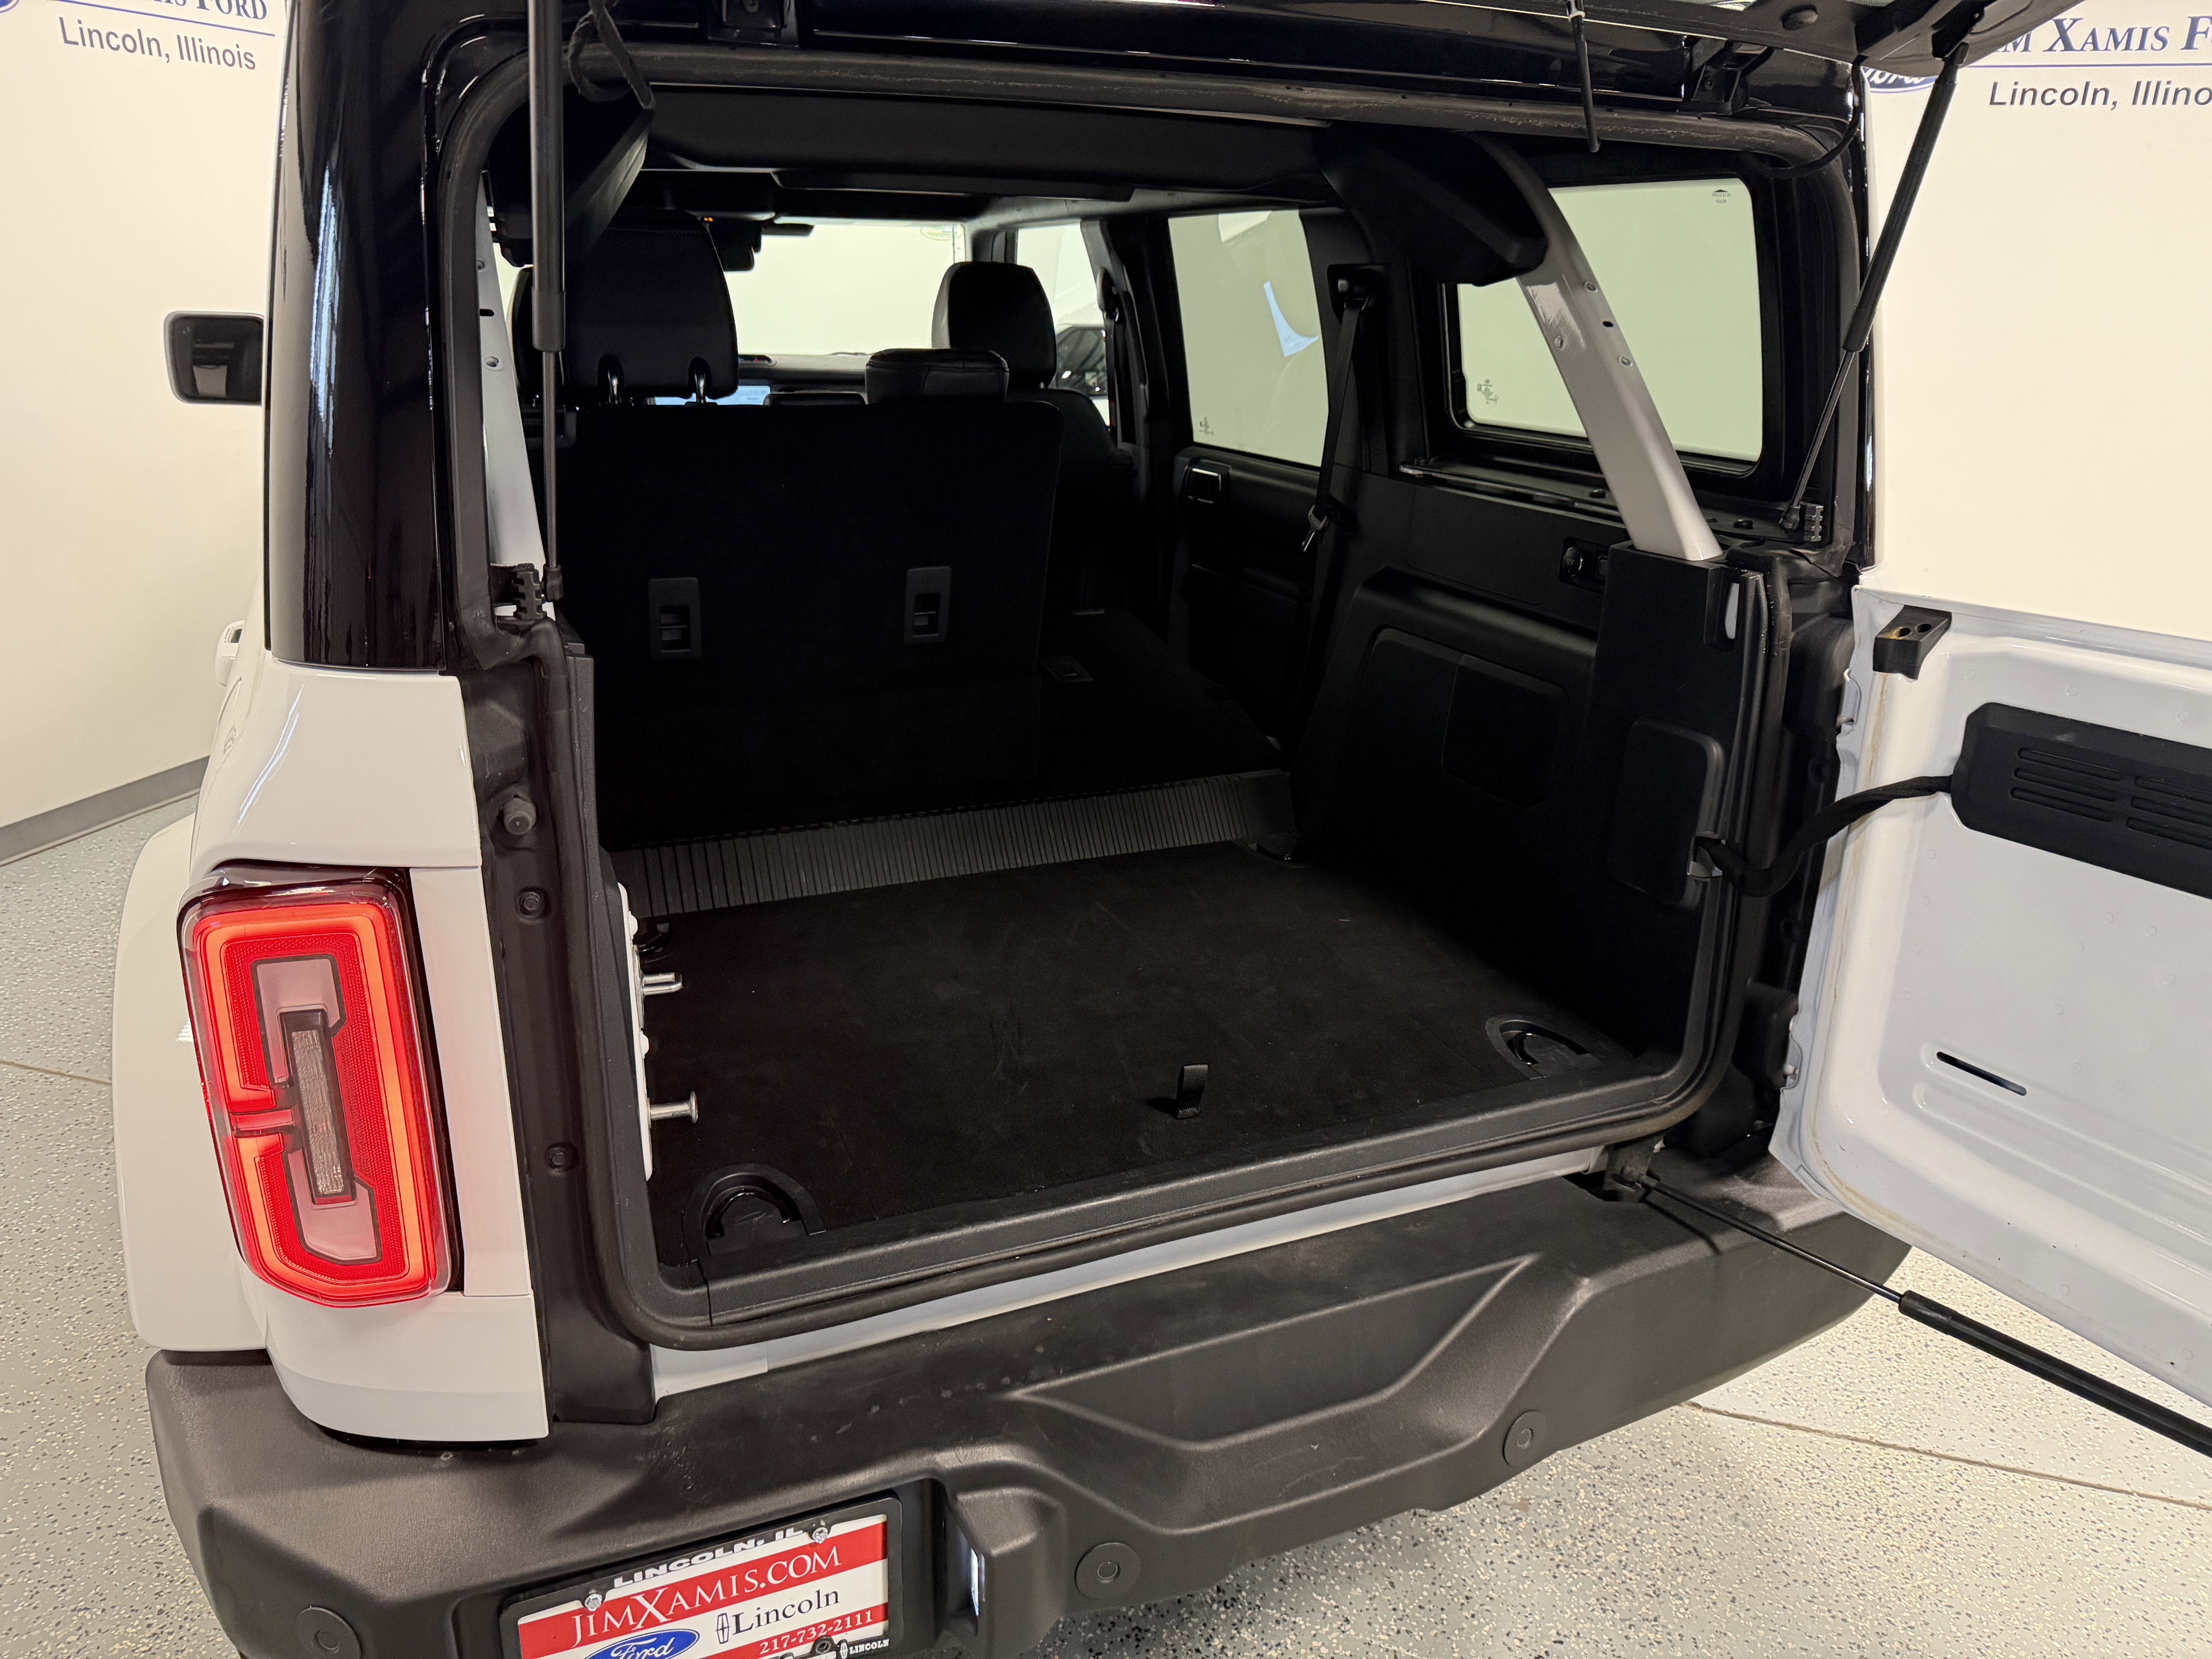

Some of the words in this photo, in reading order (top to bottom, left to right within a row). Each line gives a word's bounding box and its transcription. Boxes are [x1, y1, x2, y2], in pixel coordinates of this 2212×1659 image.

[197, 0, 267, 20] ORD
[59, 17, 170, 64] Lincoln,
[176, 34, 256, 70] Illinois
[2043, 17, 2170, 52] XAMIS
[1989, 81, 2118, 111] Lincoln,
[775, 1527, 803, 1541] IL
[571, 1546, 842, 1648] JIMXAMIS.COM
[732, 1589, 841, 1635] Lincoln
[759, 1609, 873, 1655] 217-732-2111
[849, 1638, 890, 1655] LINCOLN
